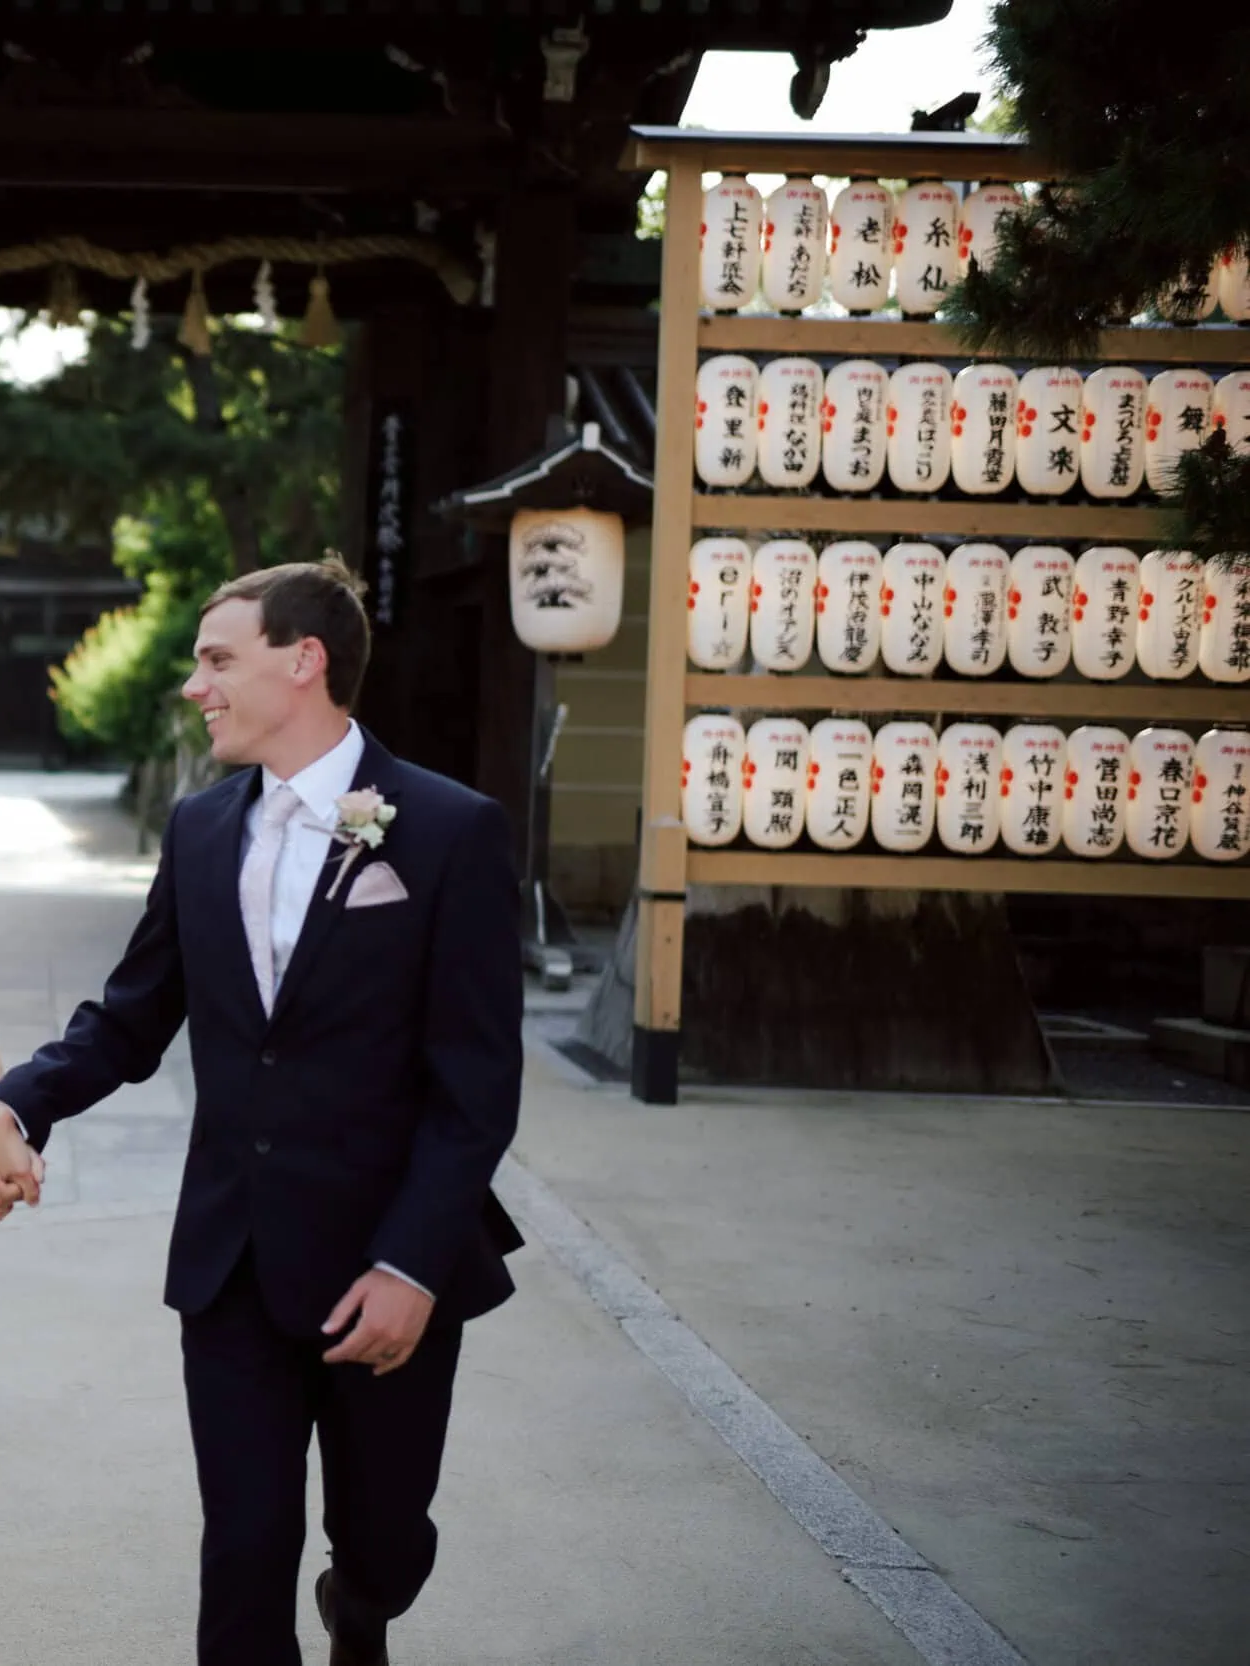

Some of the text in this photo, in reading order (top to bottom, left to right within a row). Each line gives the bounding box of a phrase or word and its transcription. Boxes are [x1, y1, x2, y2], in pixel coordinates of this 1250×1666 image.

[1100, 578, 1130, 668] 青野幸子
[828, 752, 863, 839] 一色正人
